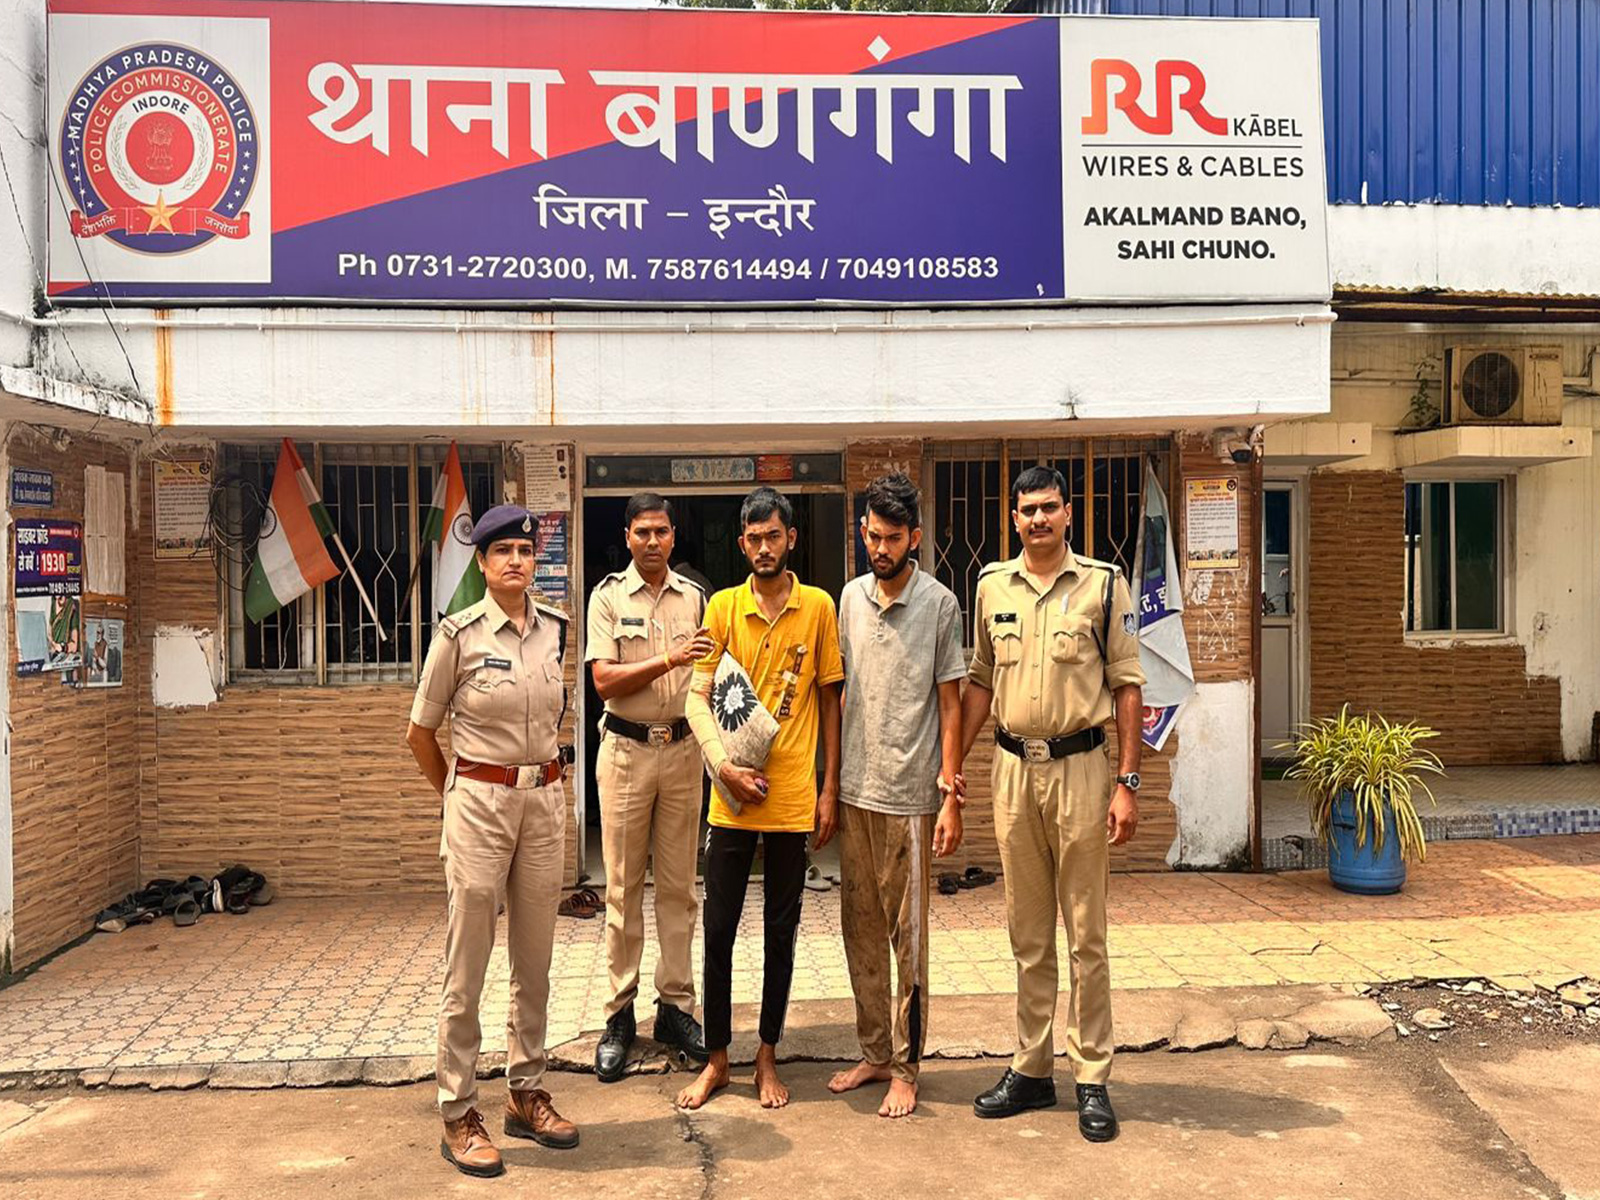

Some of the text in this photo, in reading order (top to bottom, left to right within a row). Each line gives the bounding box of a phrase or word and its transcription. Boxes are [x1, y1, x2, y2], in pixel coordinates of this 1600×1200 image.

[67, 49, 252, 142] MADHYA PRADESH POLICE
[132, 95, 190, 115] INDORE
[308, 36, 1023, 164] थाना बाणगंगा
[90, 72, 231, 174] POLICE COMMISSIONERATE
[1234, 115, 1303, 136] KĀBEL
[1083, 157, 1303, 176] WIRES & CABLES
[533, 184, 649, 230] जिला
[703, 185, 816, 239] इन्दौर
[1084, 207, 1306, 230] AKALMAND BANO,
[1118, 240, 1275, 259] SAHI CHUNO.
[339, 254, 999, 283] Ph 0731-2720300, M. 7587614494 / 7049108583
[41, 552, 66, 573] 1930
